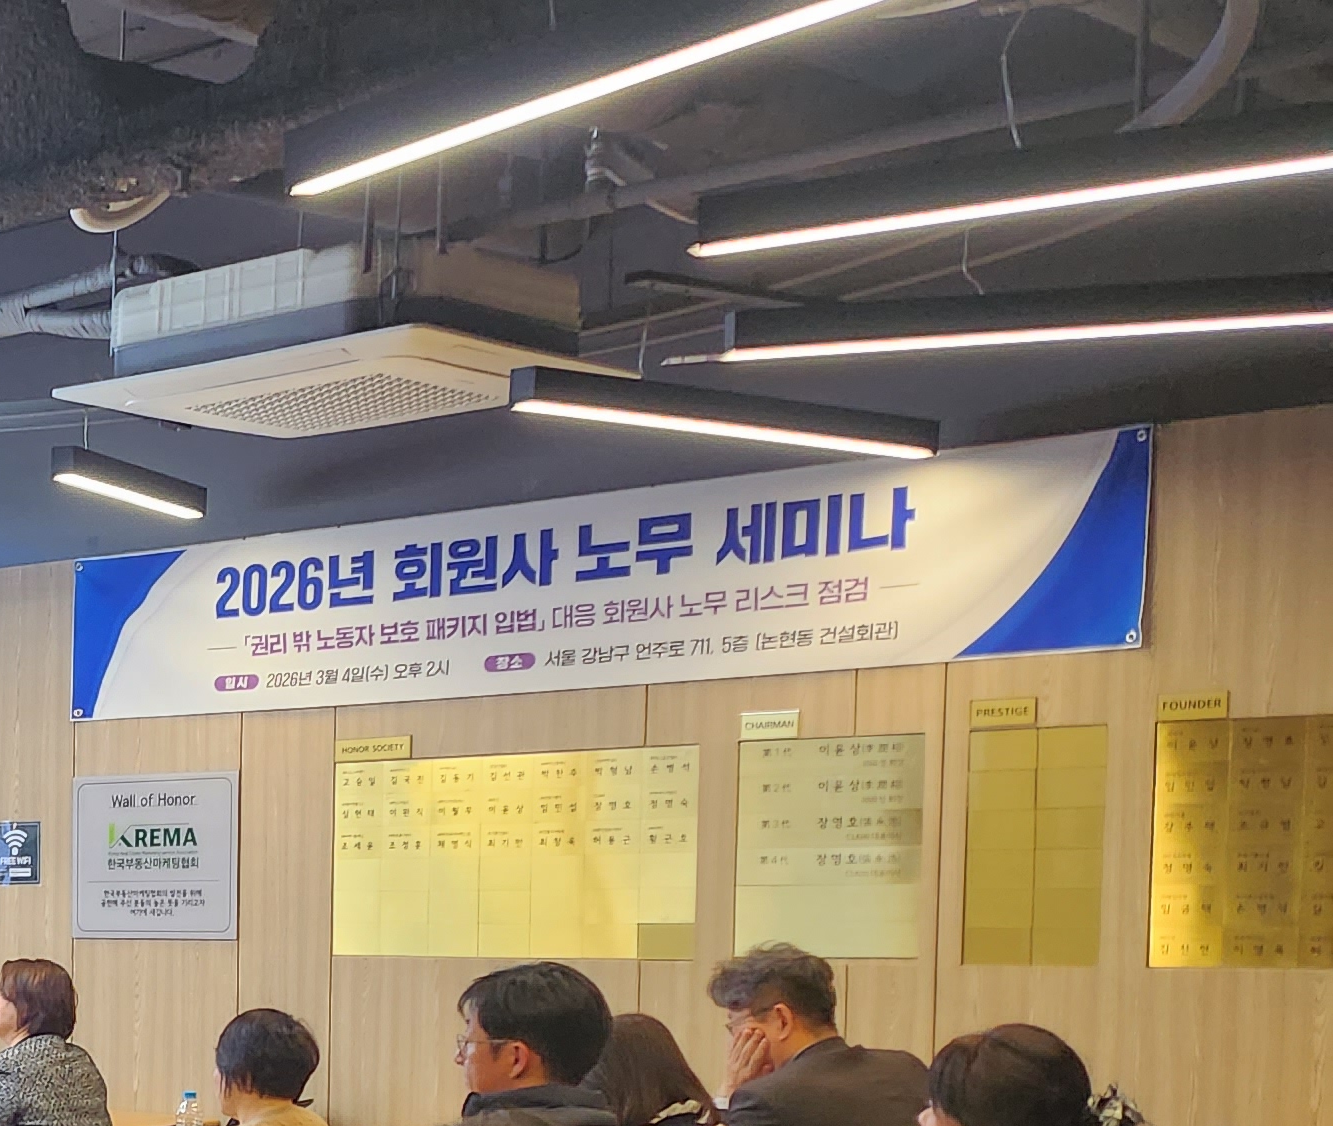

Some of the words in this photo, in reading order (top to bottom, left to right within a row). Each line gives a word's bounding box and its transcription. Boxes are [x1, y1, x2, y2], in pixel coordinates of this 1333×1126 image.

[215, 550, 376, 619] 2026년
[392, 528, 559, 602] 회원사
[575, 511, 693, 583] 노무
[715, 485, 917, 567] 세미나
[244, 632, 288, 657] 「권리
[293, 630, 312, 653] 밖
[316, 624, 375, 651] 노동자
[379, 620, 421, 646] 보호
[426, 612, 488, 642] 패키지
[494, 608, 547, 635] 입법」
[552, 604, 596, 630] 대응
[603, 595, 674, 625] 회원사
[680, 590, 728, 619] 노무
[735, 582, 809, 614] 리스크
[818, 577, 870, 605] 점검
[224, 676, 249, 690] 일시
[266, 671, 312, 689] 2026년
[316, 668, 339, 686] 3월
[341, 664, 389, 684] 4일(수)
[393, 662, 423, 680] 오후
[426, 659, 451, 678] 2시
[495, 655, 524, 669] 장소
[544, 648, 577, 667] 서울
[581, 644, 630, 665] 강남구
[635, 640, 685, 661] 언주로
[721, 635, 749, 654] 5층
[976, 706, 1030, 717] PRESTIGE
[1162, 698, 1222, 711] FOUNDER
[745, 720, 795, 731] CHAIRMAN
[341, 745, 369, 754] HONOR
[372, 743, 405, 752] SOCIETY
[111, 794, 136, 808] Wall
[141, 793, 154, 807] of
[158, 792, 196, 807] Honor
[108, 823, 198, 848] KREMA
[0, 857, 17, 866] FREE
[108, 857, 200, 871] 한국부동산마케팅협회
